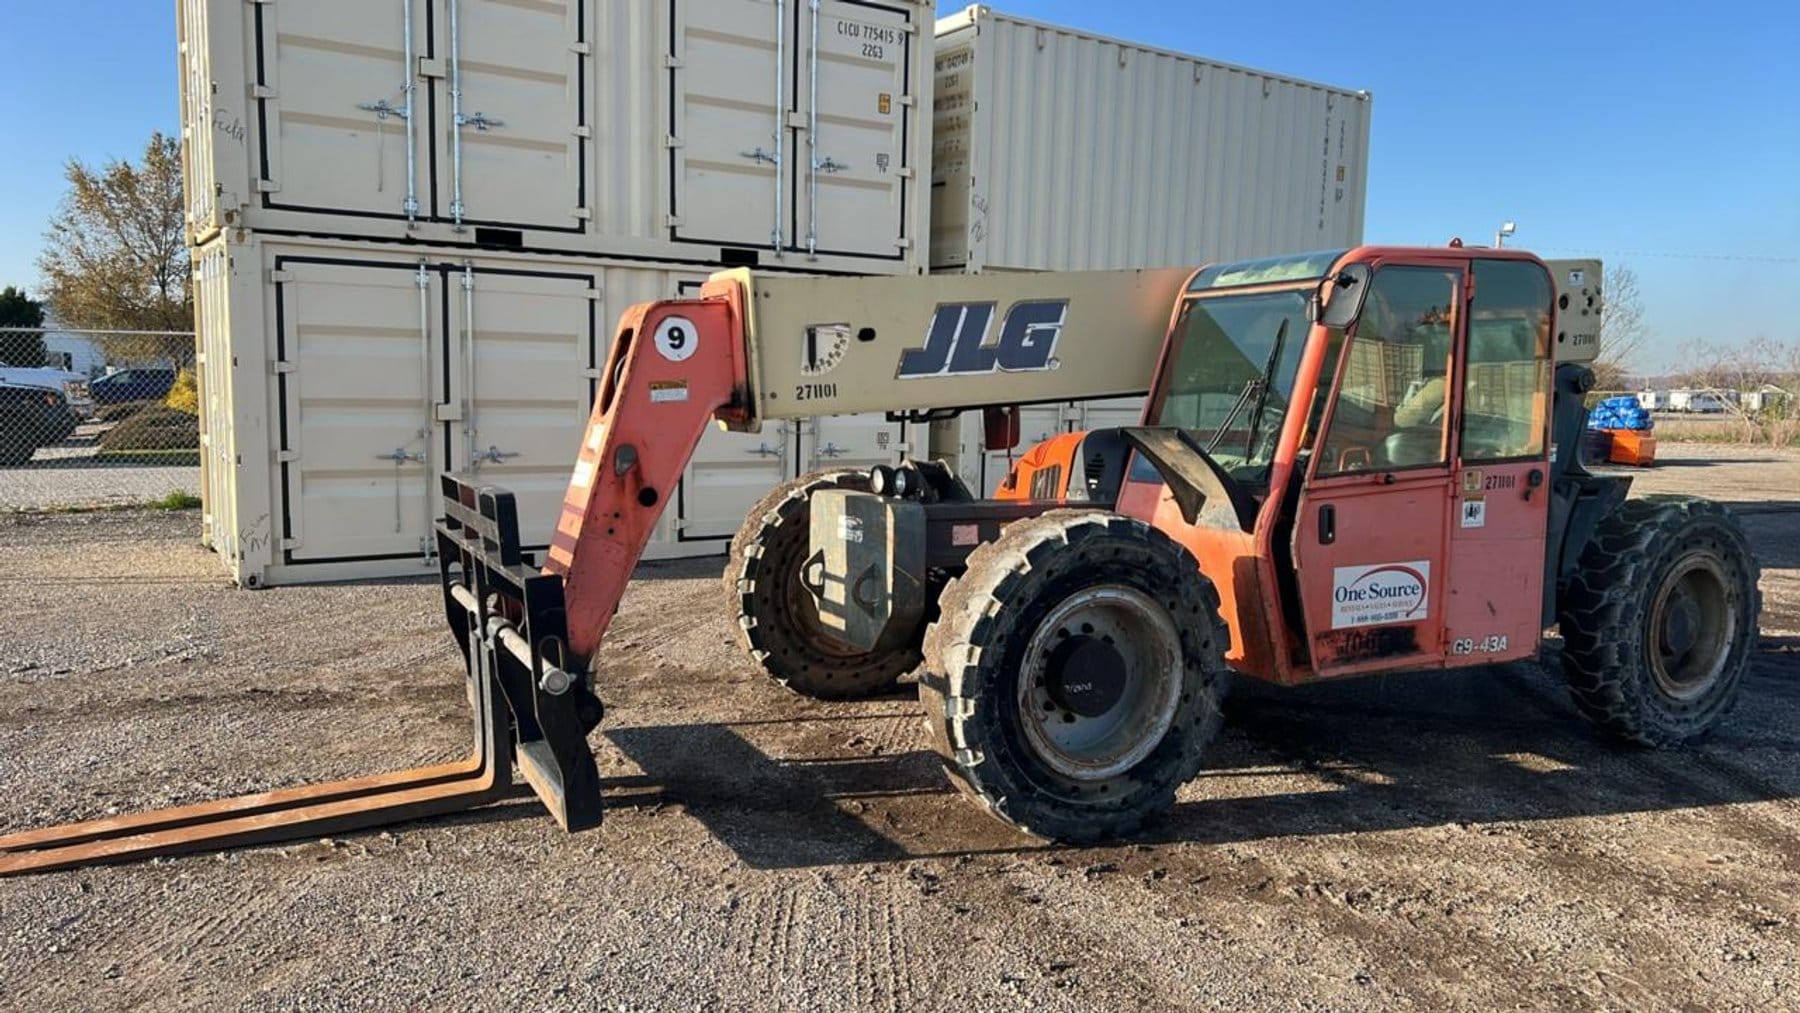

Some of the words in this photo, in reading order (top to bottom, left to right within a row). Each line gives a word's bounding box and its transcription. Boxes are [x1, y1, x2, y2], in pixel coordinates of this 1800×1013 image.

[837, 21, 860, 37] CICU
[863, 25, 894, 44] 775415
[898, 32, 904, 45] 9
[667, 326, 686, 350] 9
[895, 299, 1070, 380] JLG
[796, 383, 837, 401] 271101
[1485, 475, 1516, 490] 271101
[1335, 586, 1367, 603] One
[1368, 583, 1420, 600] Source
[1452, 635, 1508, 655] G9-43A
